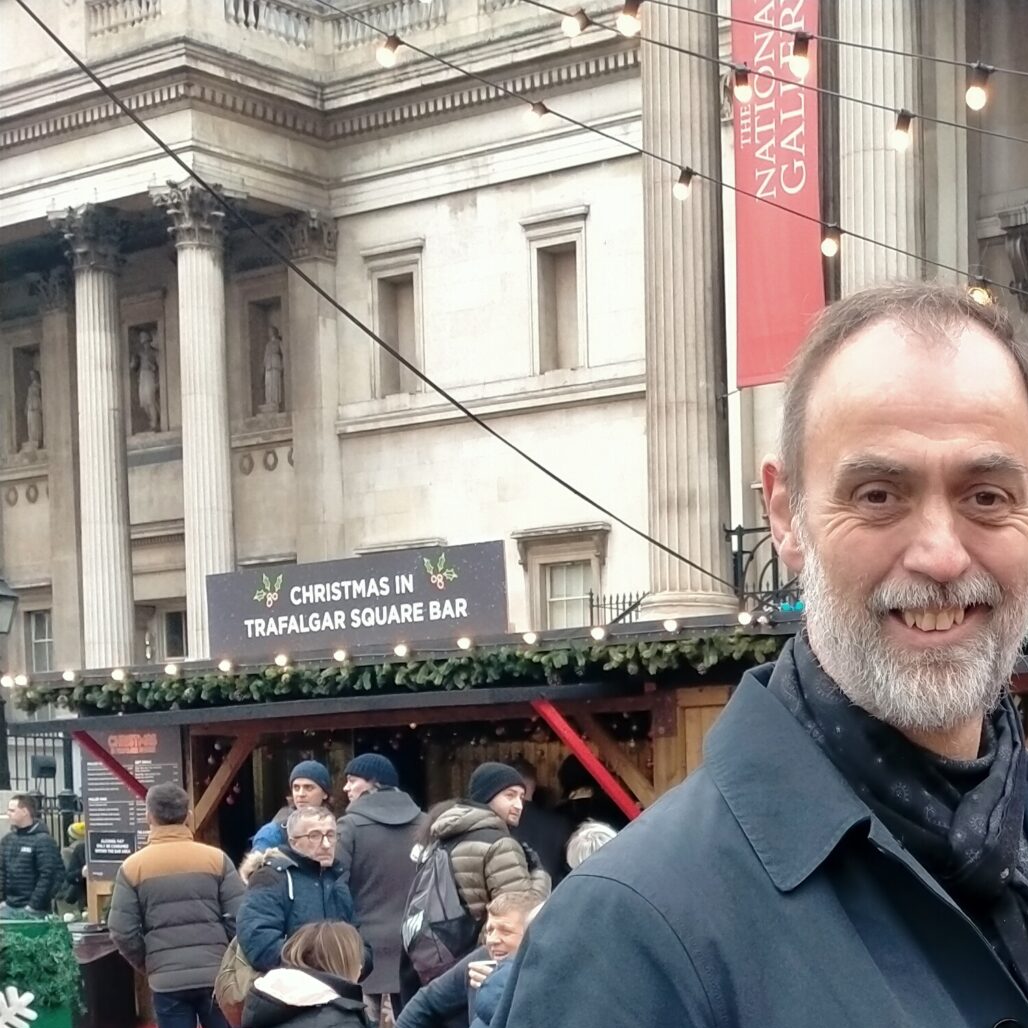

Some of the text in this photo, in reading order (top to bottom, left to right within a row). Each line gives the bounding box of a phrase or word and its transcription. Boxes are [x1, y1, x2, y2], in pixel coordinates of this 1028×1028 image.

[754, 0, 777, 202] NATIONA
[780, 0, 807, 194] GALLER
[740, 104, 752, 149] THE
[290, 574, 413, 605] CHRISTMAS IN
[244, 598, 468, 638] TRAFALGAR SQUARE BAR
